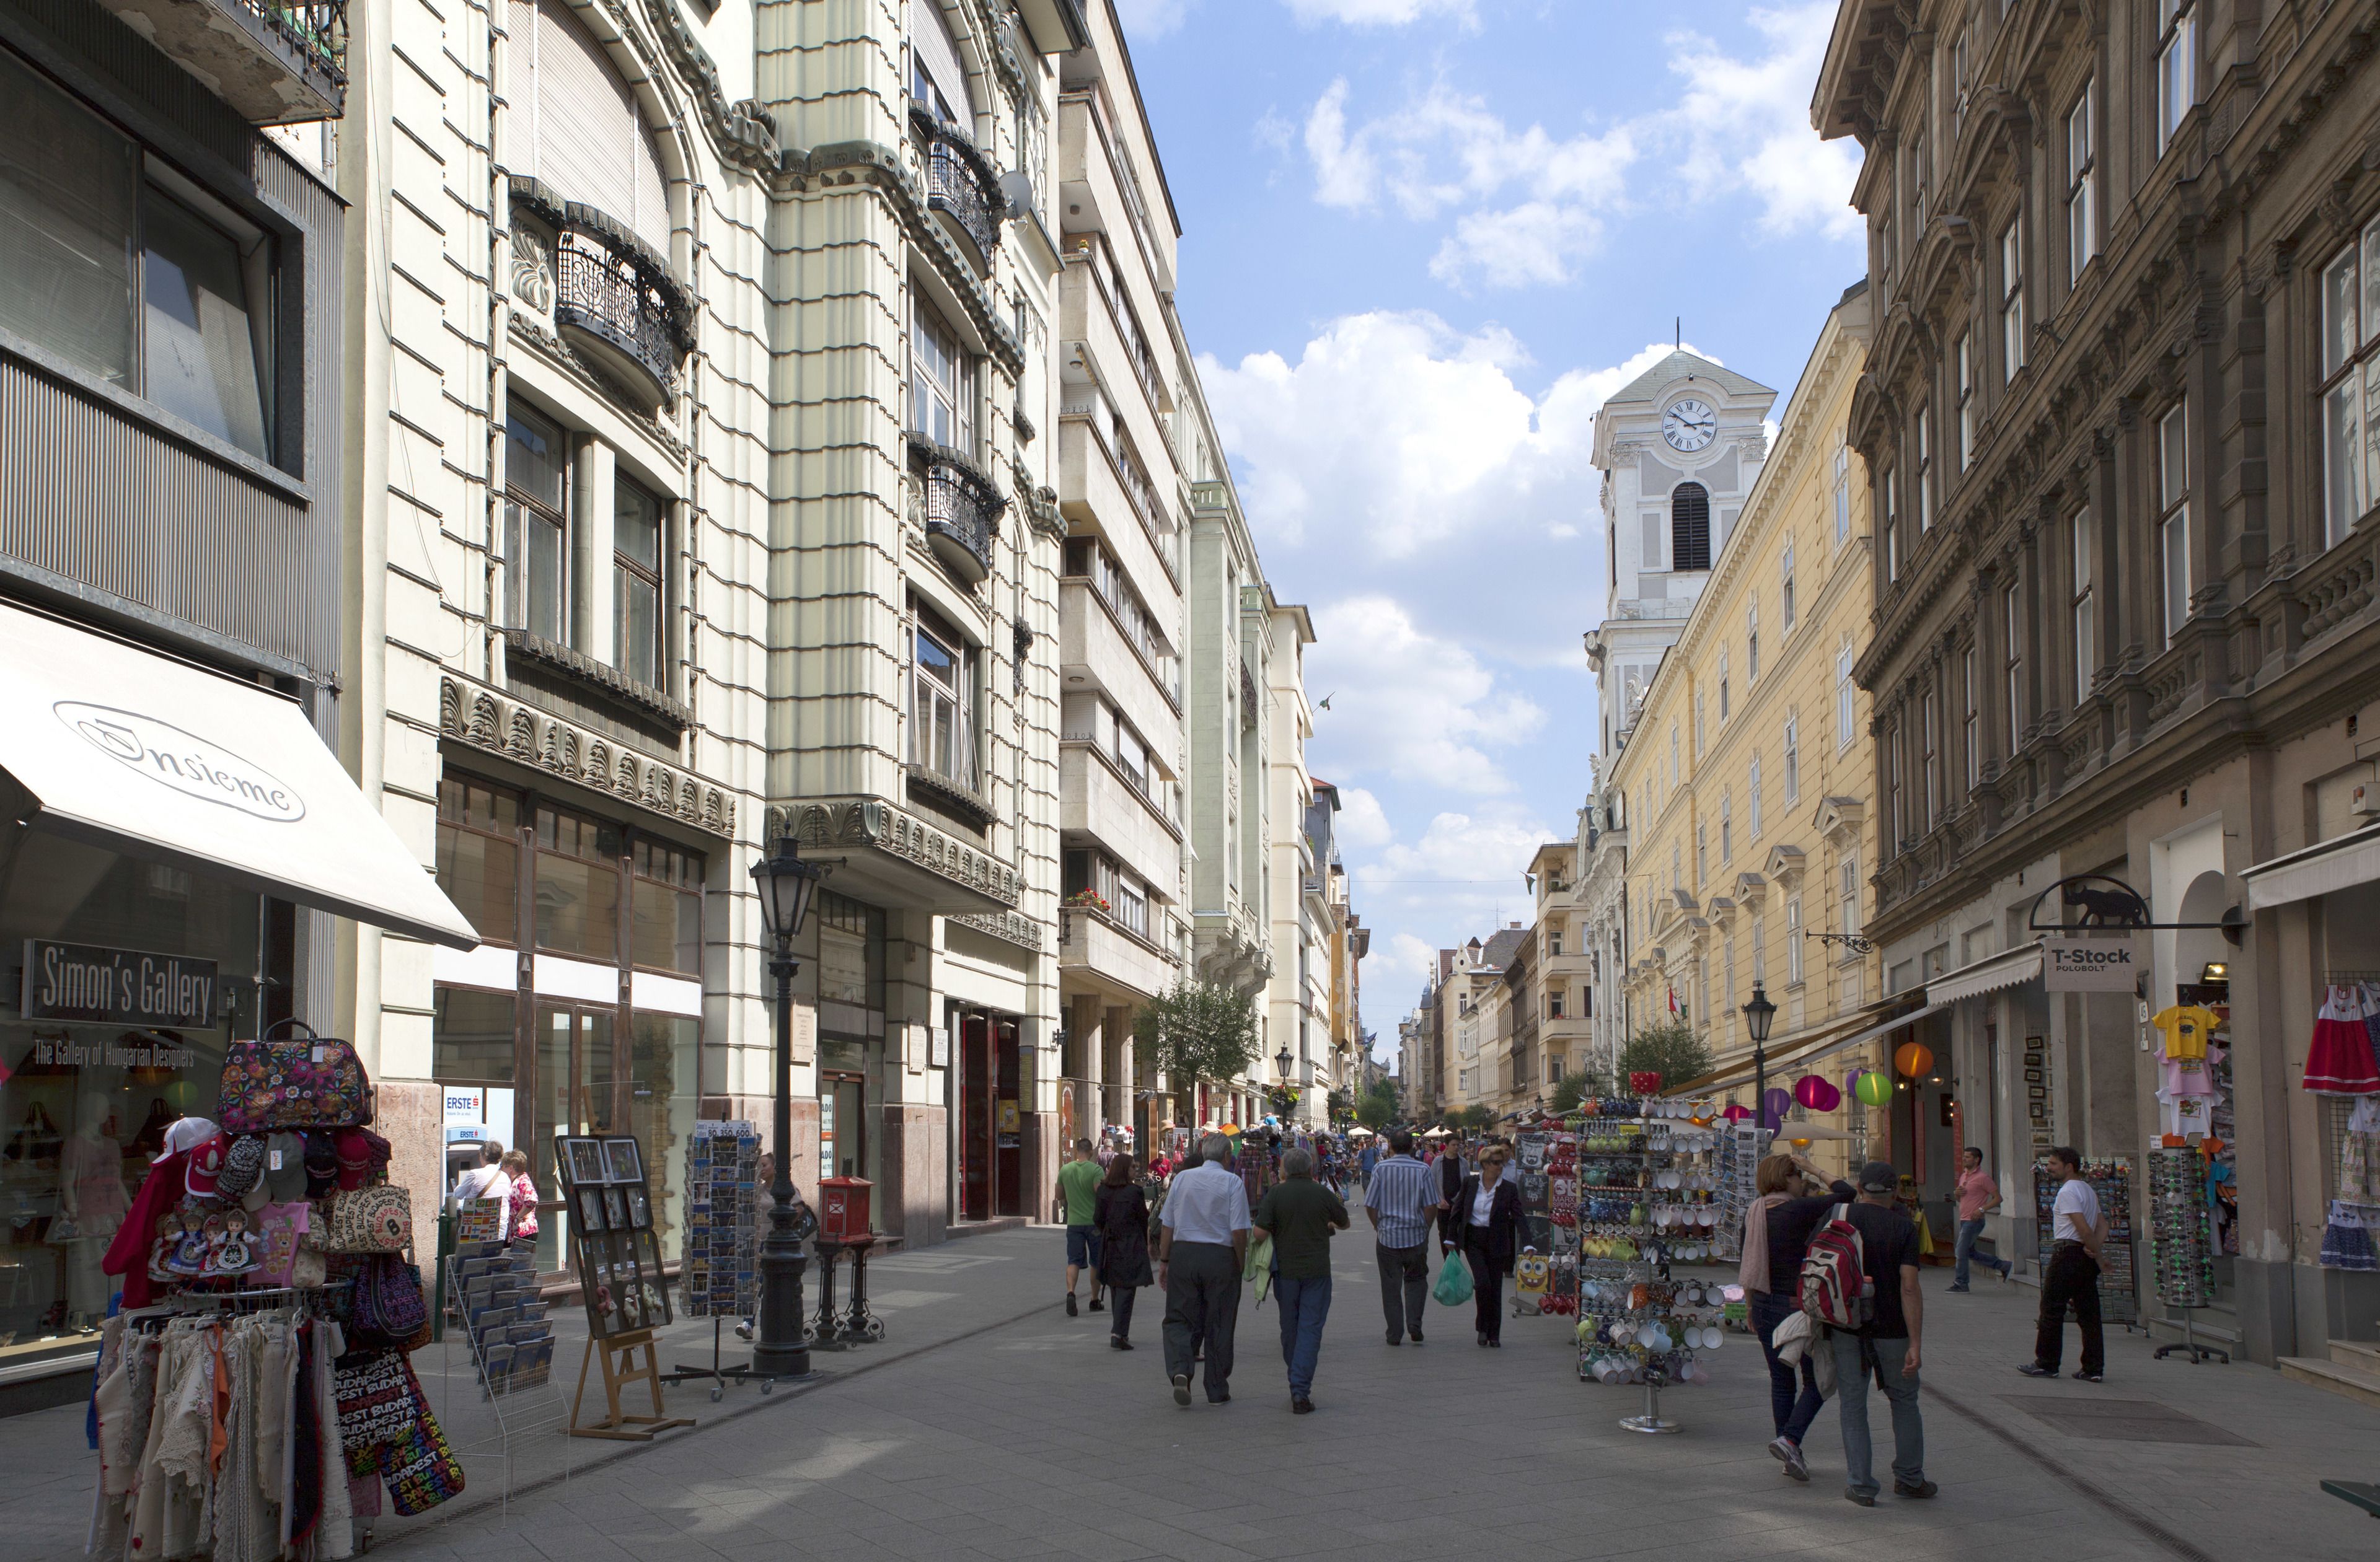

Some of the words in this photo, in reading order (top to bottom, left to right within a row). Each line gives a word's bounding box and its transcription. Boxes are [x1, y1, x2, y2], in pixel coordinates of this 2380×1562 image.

[77, 718, 289, 811] Insieme
[2052, 949, 2131, 963] T-Stock
[43, 946, 133, 1012] Simon's
[140, 957, 211, 1025] Gallery
[35, 1039, 53, 1065] The
[56, 1040, 90, 1068] Gallery
[93, 1041, 102, 1066] of
[105, 1042, 151, 1069] Hungarian
[153, 1043, 195, 1070] Designers
[447, 1097, 471, 1109] ERSTE
[736, 1130, 750, 1138] 600
[356, 1196, 372, 1230] BUDAPEST
[368, 1198, 395, 1218] BUDAPEST
[375, 1208, 404, 1234] BUDAPEST
[345, 1206, 357, 1244] BUDAPEST
[383, 1450, 438, 1487] BUDAPEST
